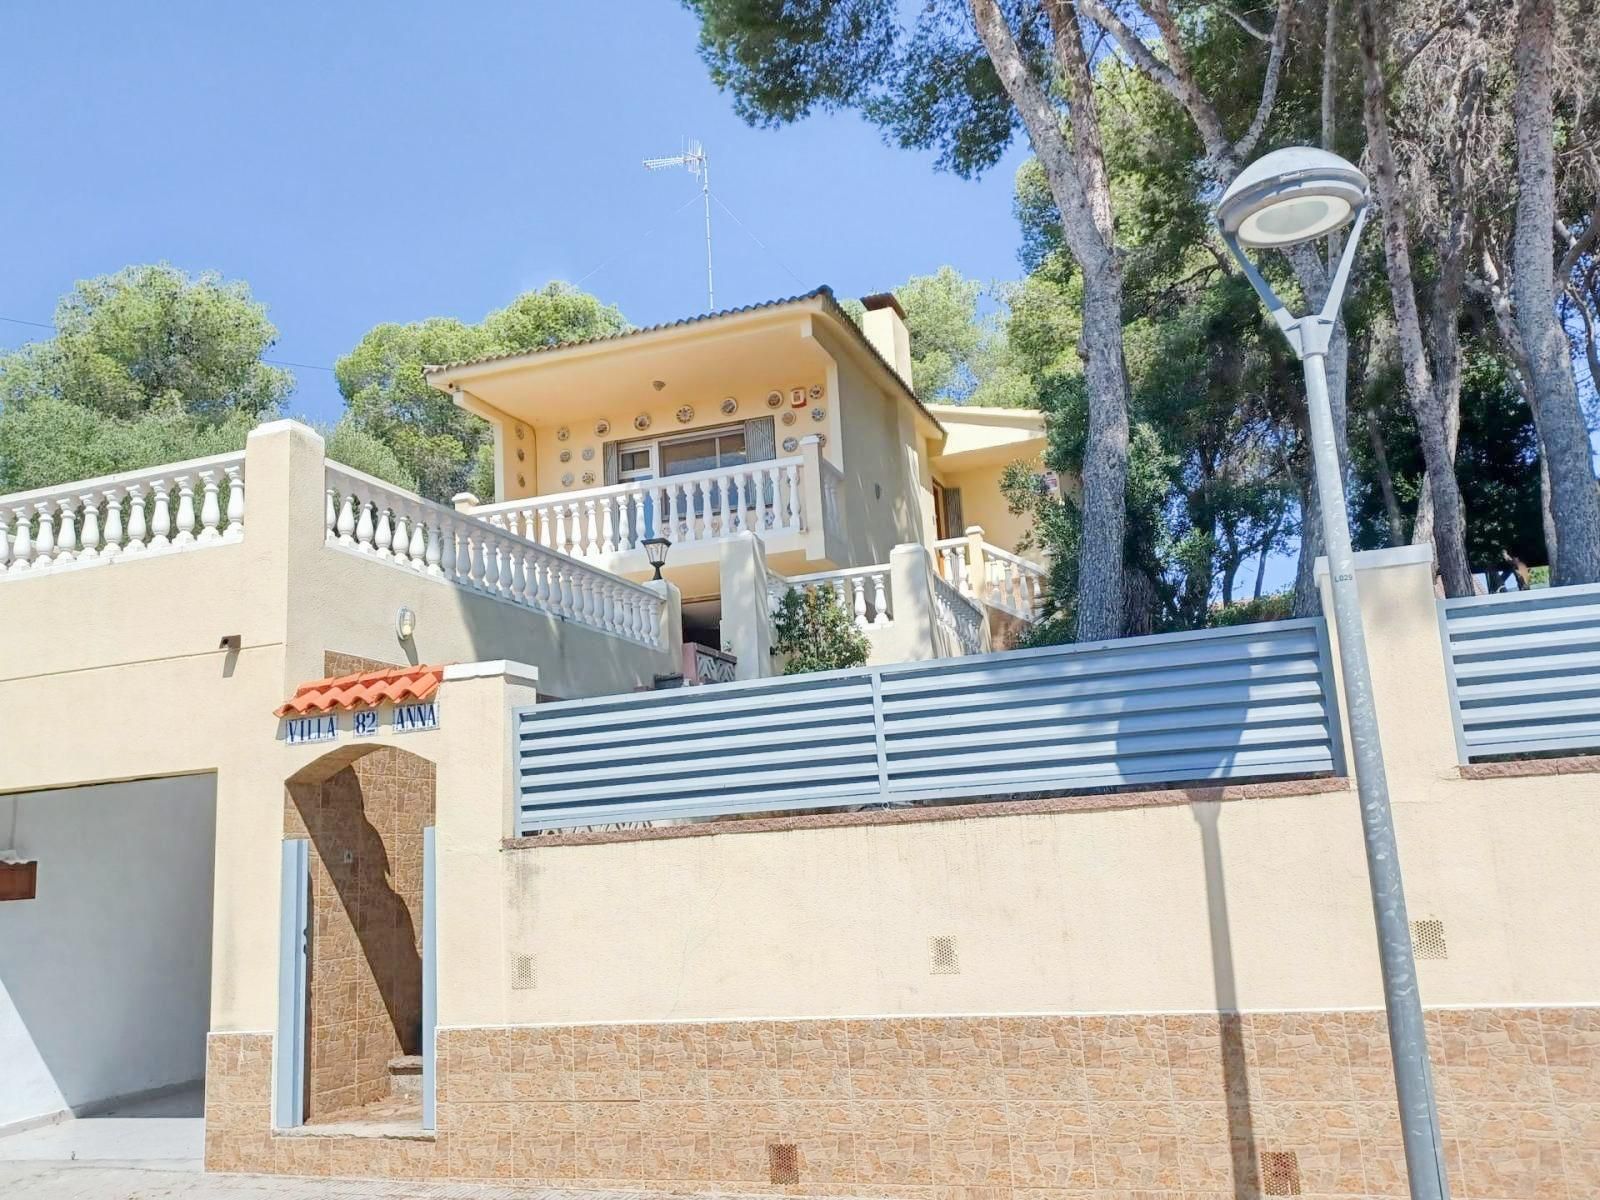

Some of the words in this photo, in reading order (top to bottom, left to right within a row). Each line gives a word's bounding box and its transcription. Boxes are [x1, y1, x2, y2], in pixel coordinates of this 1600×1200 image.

[288, 717, 335, 742] VILLA
[355, 711, 376, 734] 82
[395, 705, 436, 729] ANNA
